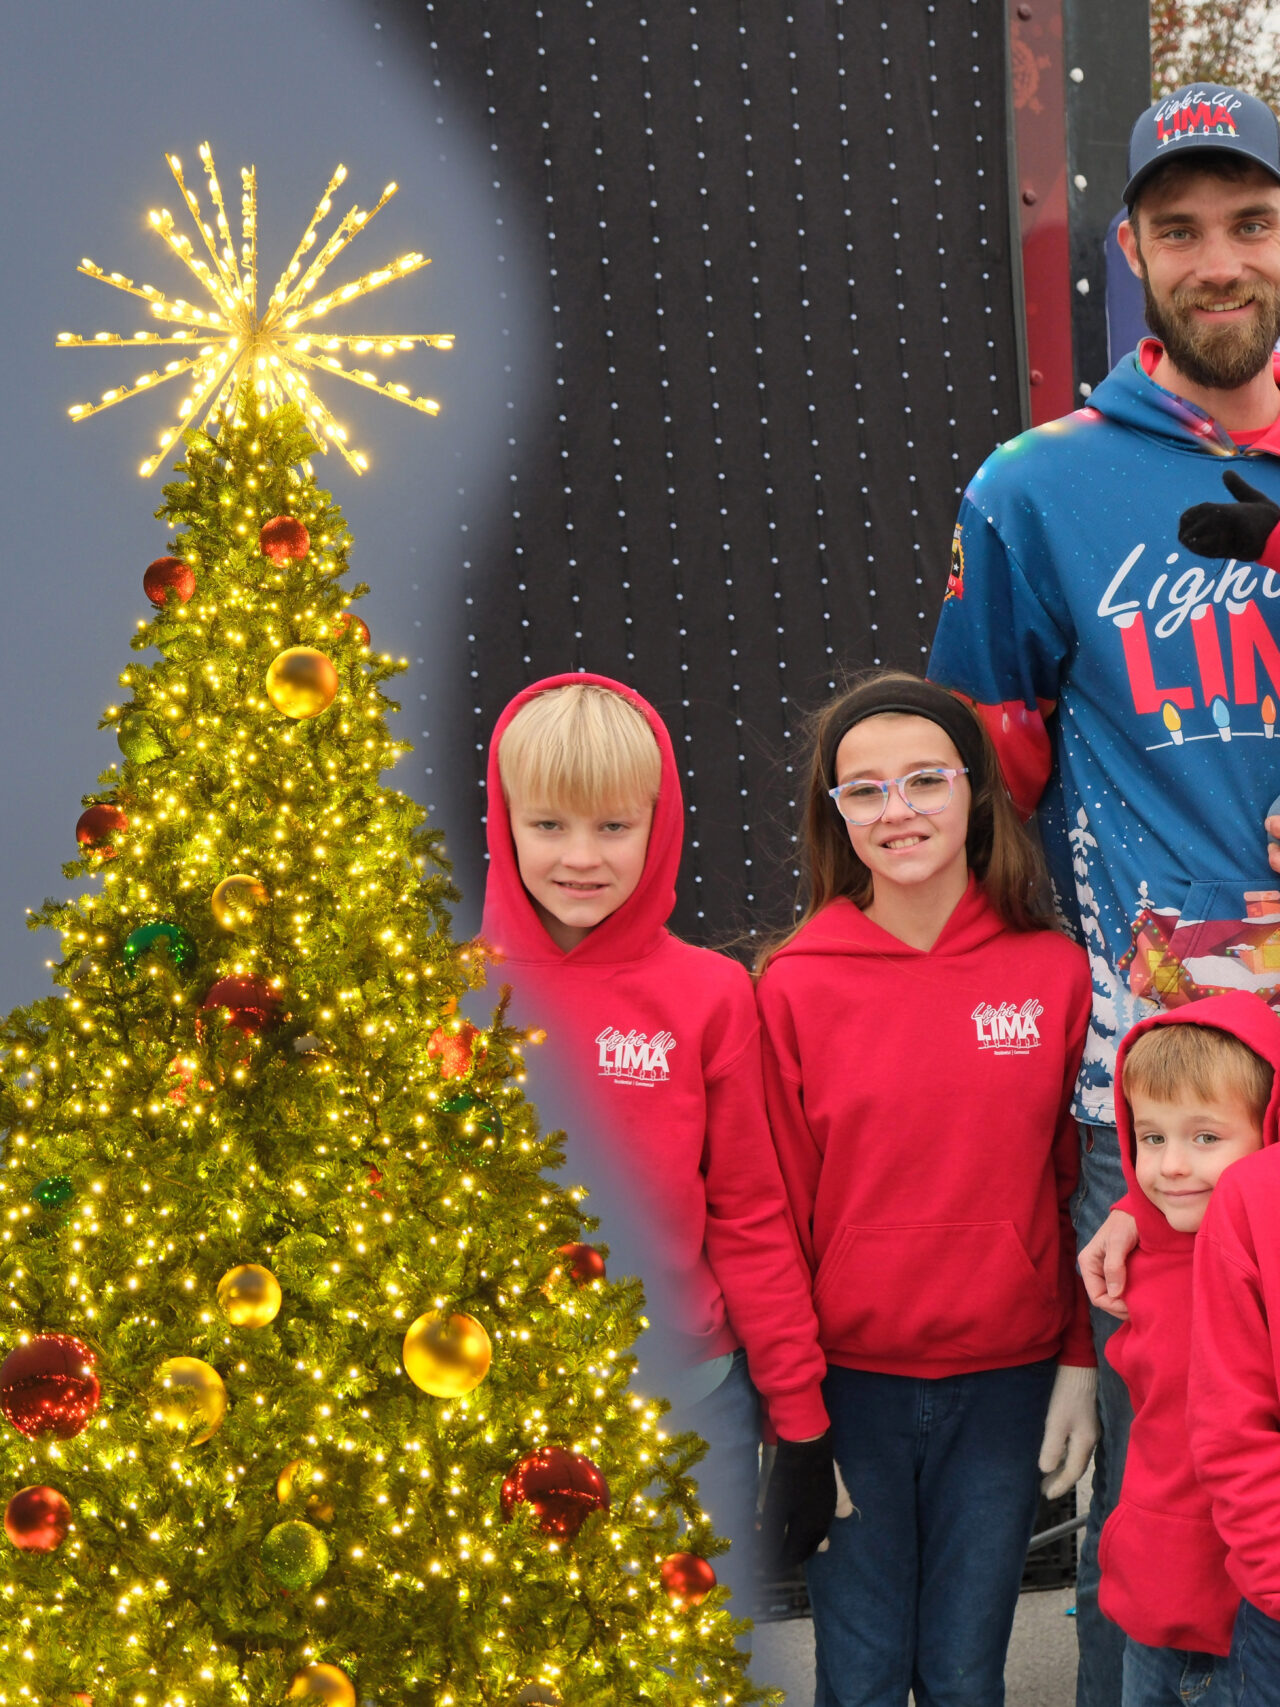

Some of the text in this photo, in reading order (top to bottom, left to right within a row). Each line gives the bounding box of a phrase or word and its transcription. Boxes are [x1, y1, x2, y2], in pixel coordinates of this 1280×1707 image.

[1154, 90, 1242, 121] Light Up
[1157, 100, 1237, 140] LIMA
[971, 998, 1044, 1026] Light Up
[976, 1013, 1040, 1041] LIMA
[595, 1026, 677, 1056] Light Up
[599, 1039, 670, 1073] LIMA
